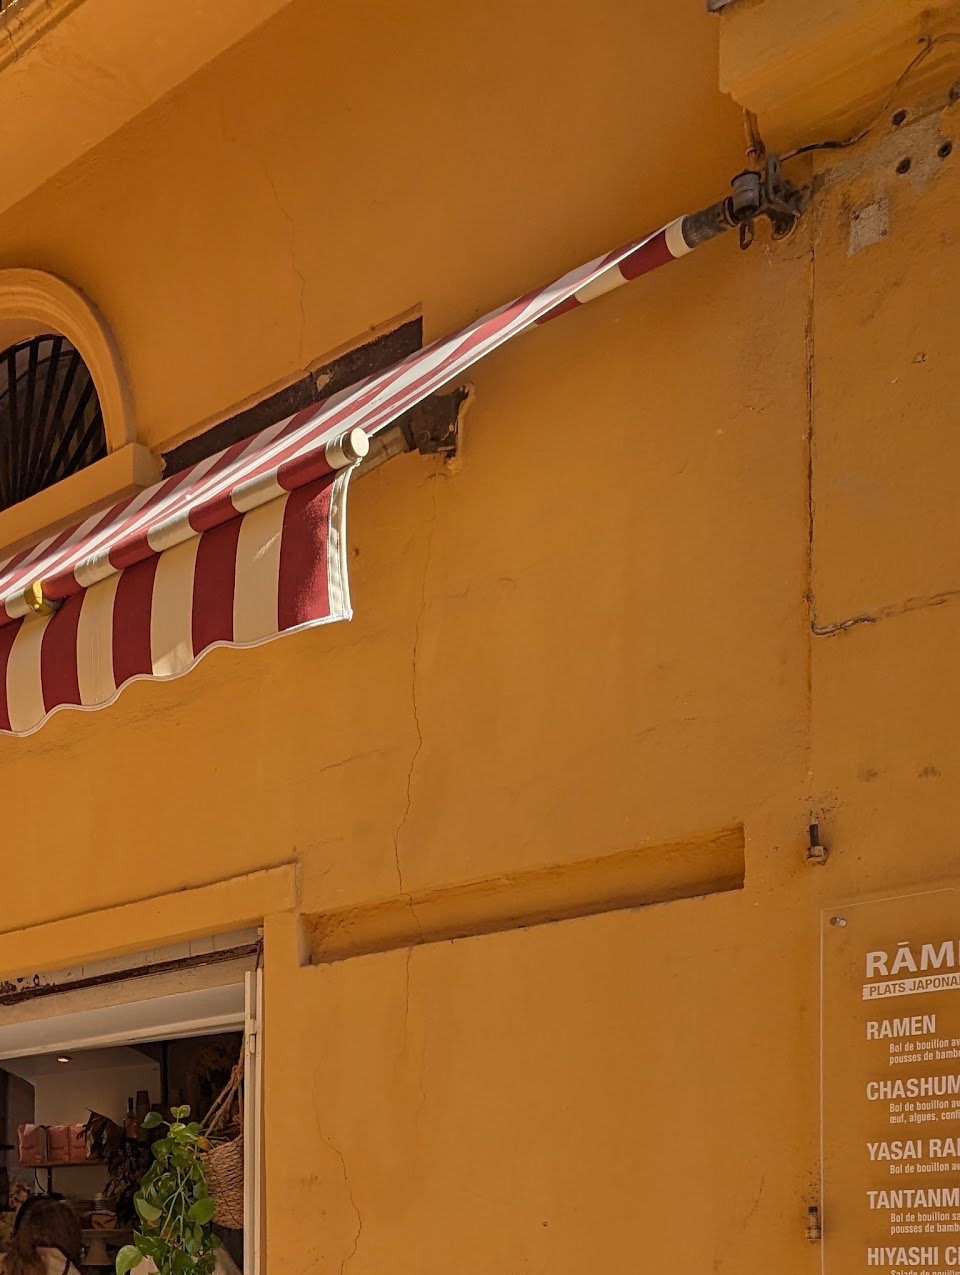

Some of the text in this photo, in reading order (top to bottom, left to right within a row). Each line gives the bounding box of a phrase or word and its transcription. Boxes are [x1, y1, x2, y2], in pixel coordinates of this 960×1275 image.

[866, 940, 960, 978] RĀM
[870, 983, 905, 996] PLATS
[867, 1014, 936, 1040] RAMEN
[890, 1043, 902, 1053] Bol
[905, 1042, 914, 1051] de
[916, 1039, 948, 1050] bouillon
[890, 1053, 921, 1066] pousses
[924, 1051, 933, 1060] de
[890, 1103, 902, 1112] Bol
[905, 1102, 914, 1111] de
[917, 1099, 949, 1111] bouillon
[909, 1113, 938, 1123] algues,
[867, 1138, 960, 1160] YASAI RA
[890, 1164, 902, 1174] Bol
[905, 1164, 914, 1173] de
[917, 1162, 949, 1173] bouillon
[866, 1188, 959, 1209] TANTANM
[891, 1213, 903, 1222] Bol
[906, 1212, 915, 1222] de
[918, 1212, 949, 1222] bouillon
[891, 1223, 960, 1235] pousses de bamb
[868, 1246, 938, 1266] HIYASHI
